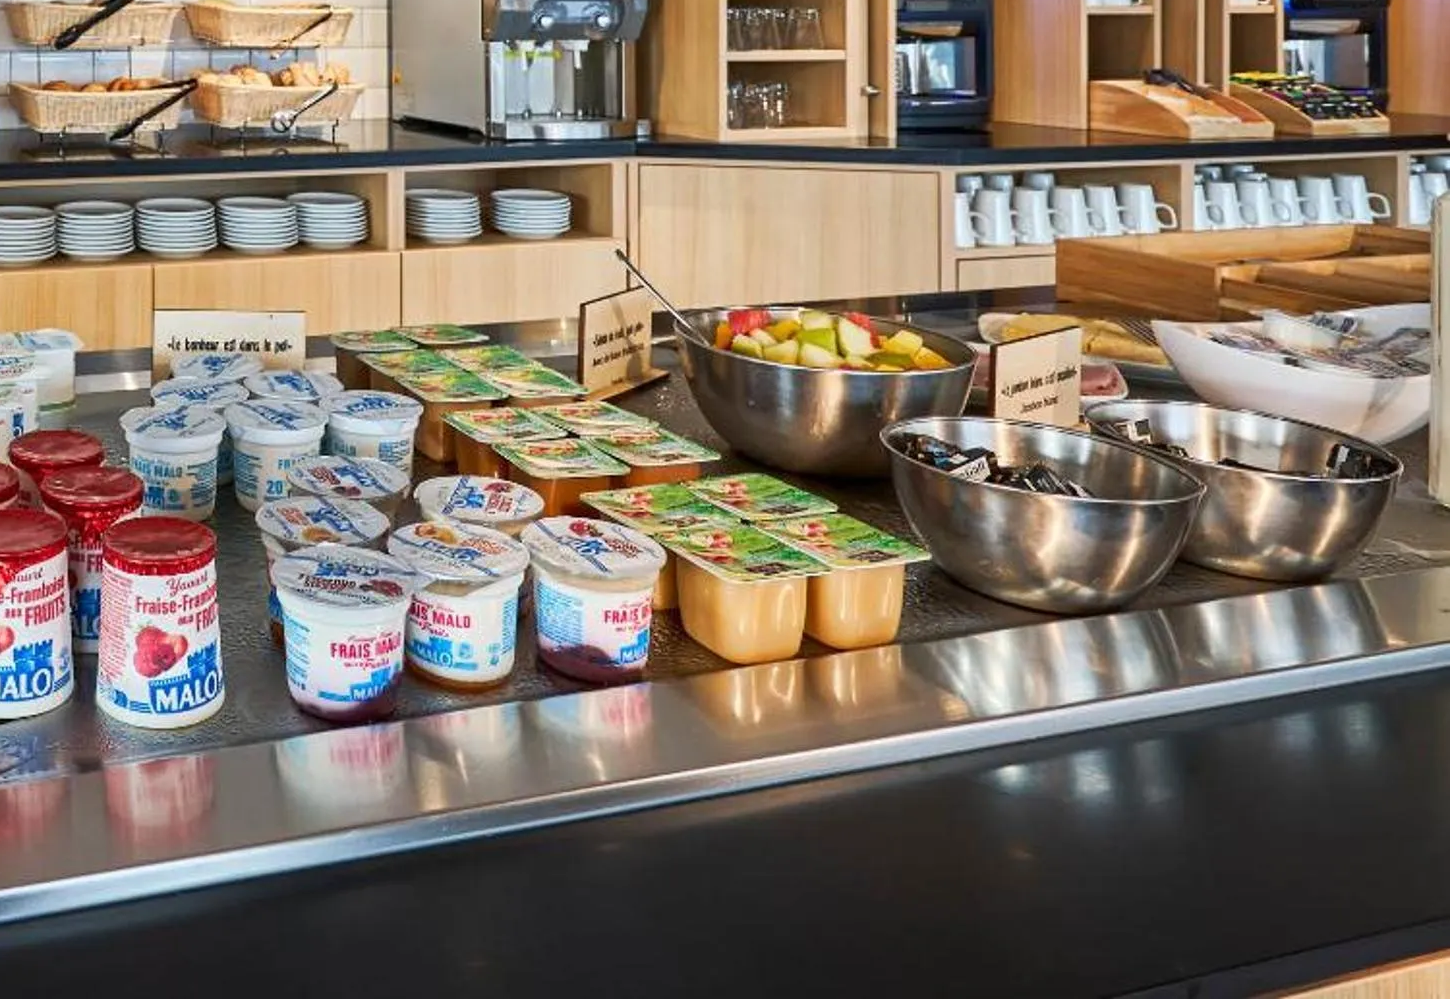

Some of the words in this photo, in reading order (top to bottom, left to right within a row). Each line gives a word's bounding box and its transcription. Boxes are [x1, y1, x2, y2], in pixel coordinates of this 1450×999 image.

[24, 594, 66, 627] FRUITS
[409, 601, 428, 621] AIS
[432, 610, 471, 628] MALO
[604, 608, 639, 624] FRAIS
[330, 642, 371, 659] FRAIS
[156, 670, 218, 712] MALO
